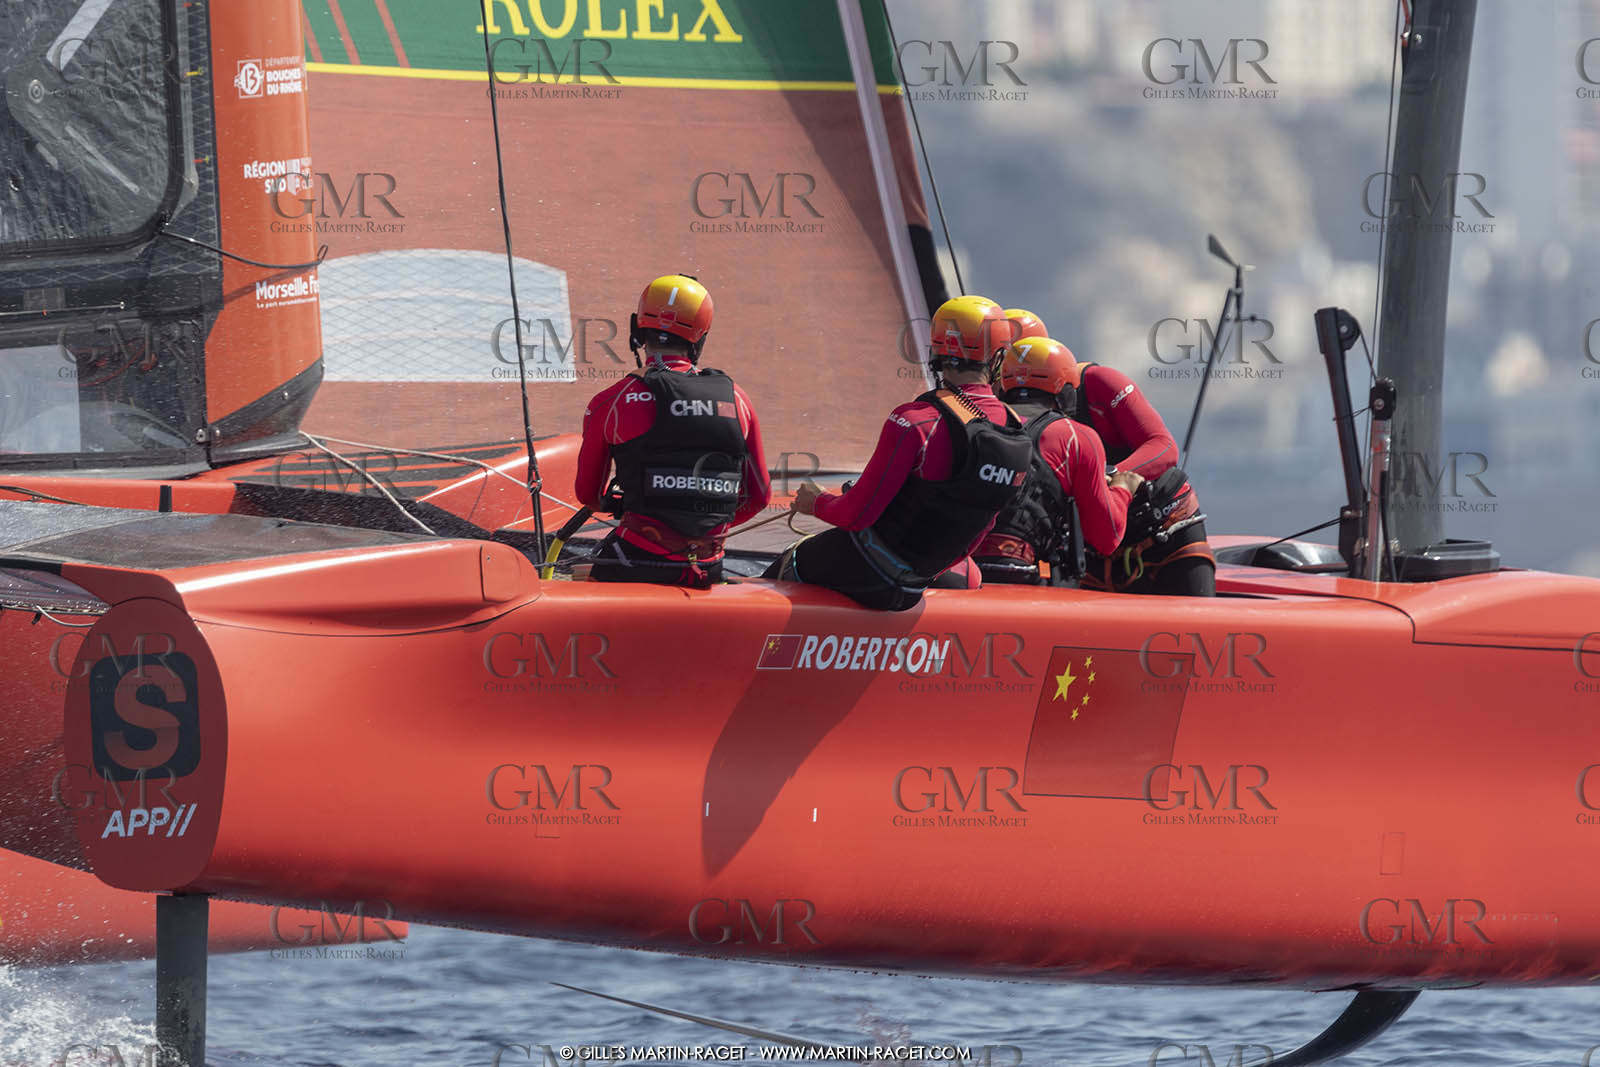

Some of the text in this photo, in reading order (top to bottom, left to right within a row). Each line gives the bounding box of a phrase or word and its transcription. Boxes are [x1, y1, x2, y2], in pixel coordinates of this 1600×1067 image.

[476, 0, 743, 43] ROLEX
[267, 83, 279, 95] DU
[243, 160, 286, 179] RÉGION
[264, 178, 286, 194] SUD
[256, 277, 308, 300] Marseille
[1019, 344, 1033, 364] 7
[670, 400, 713, 416] CHN
[979, 464, 1015, 486] CHN
[797, 635, 950, 674] ROBERTSON
[103, 664, 187, 770] S
